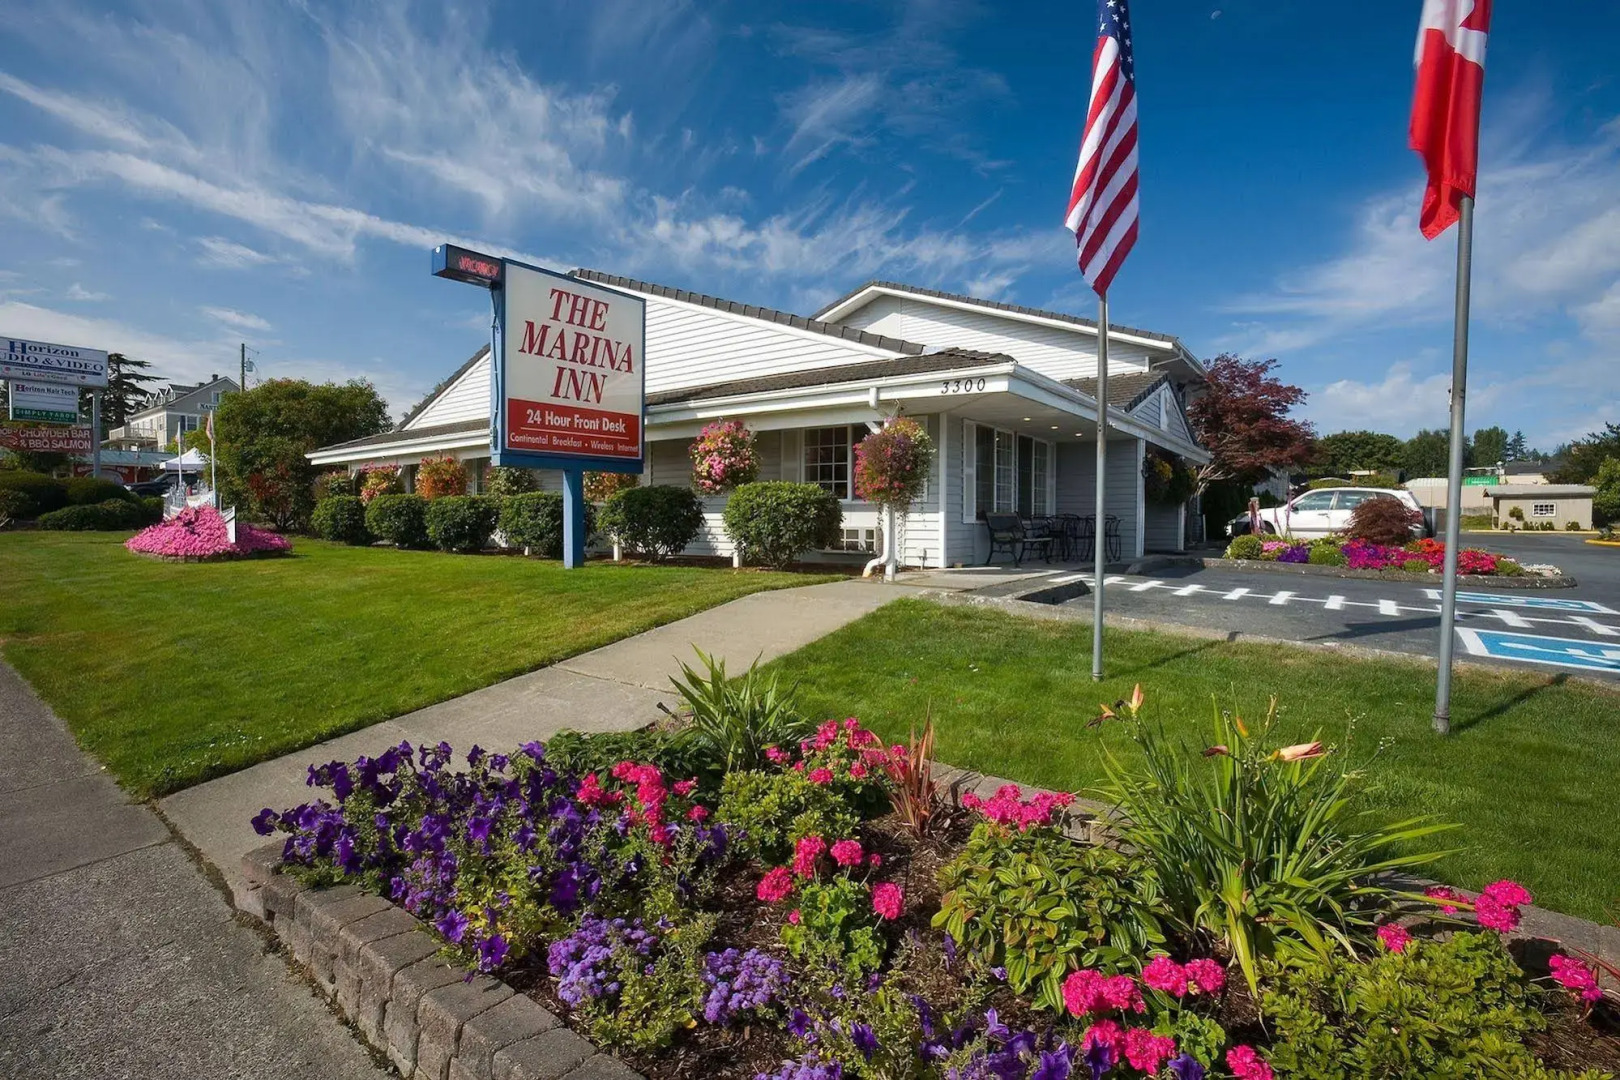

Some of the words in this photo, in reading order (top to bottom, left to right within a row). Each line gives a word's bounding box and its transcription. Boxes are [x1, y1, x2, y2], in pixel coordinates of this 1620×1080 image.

[549, 288, 609, 332] THE
[9, 341, 79, 357] Horizon
[518, 320, 634, 374] MARINA
[56, 359, 104, 371] VIDEO
[15, 384, 46, 393] Horizon
[550, 366, 608, 404] INN
[941, 378, 986, 394] 3300
[526, 409, 542, 424] 24
[545, 411, 571, 427] Hour
[574, 414, 600, 430] Front
[602, 418, 626, 433] Desk
[19, 429, 70, 438] CHOWDER
[71, 429, 91, 438] BAR
[28, 439, 50, 448] BBQ
[51, 440, 92, 449] SALMON
[509, 432, 549, 445] Continental
[552, 435, 583, 448] Breakfast
[590, 440, 615, 451] Wireless
[617, 443, 639, 452] Internet
